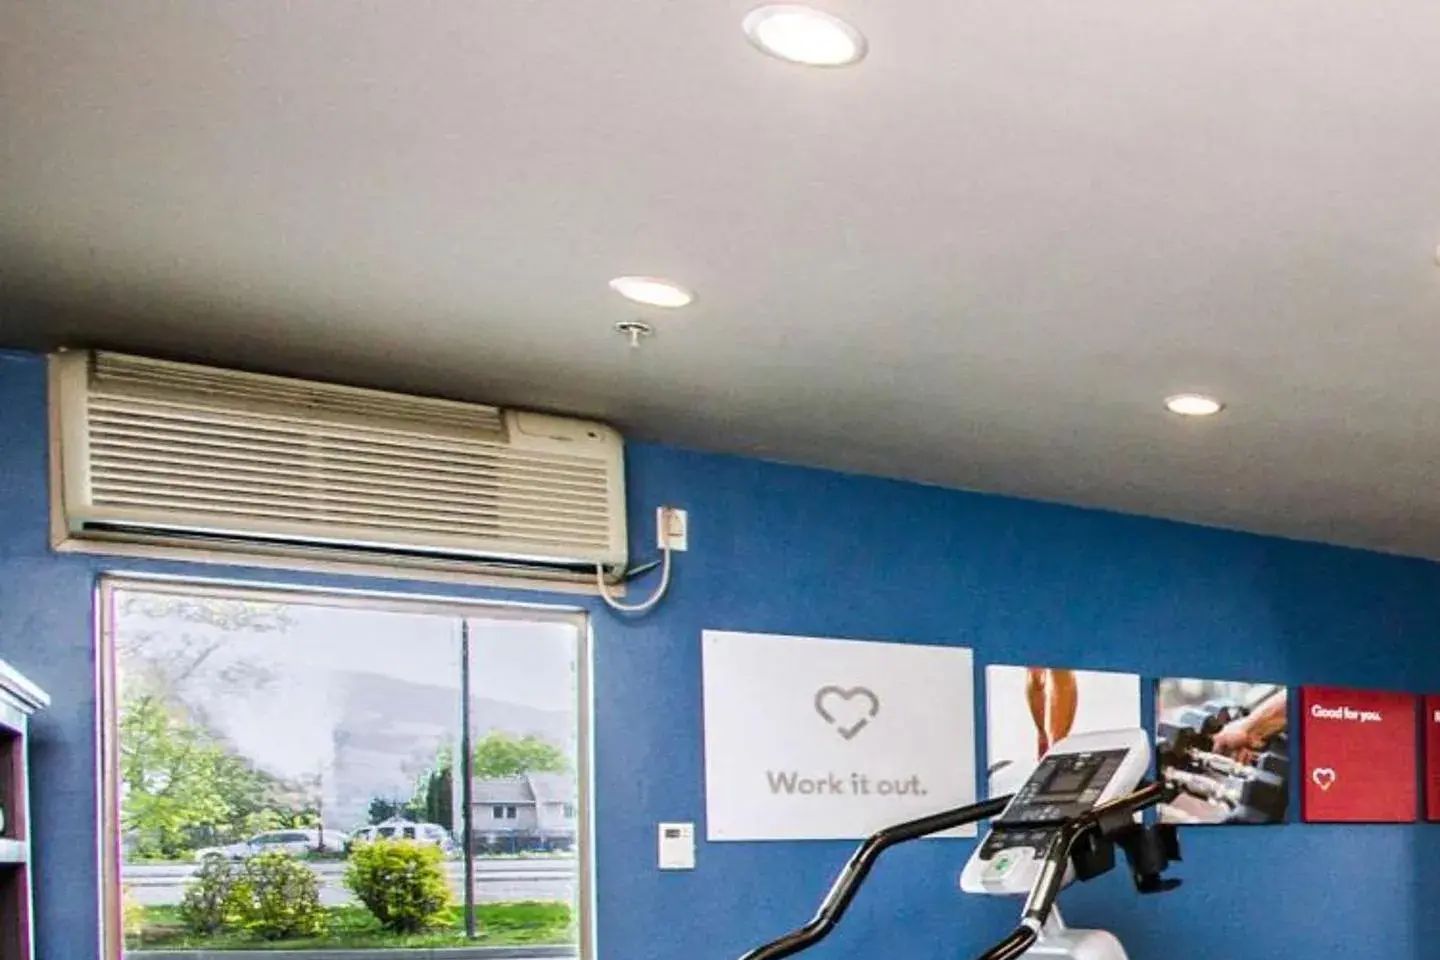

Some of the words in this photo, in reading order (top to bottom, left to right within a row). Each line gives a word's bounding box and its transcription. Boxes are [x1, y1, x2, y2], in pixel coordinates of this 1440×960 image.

[1311, 704, 1342, 719] Good
[1344, 706, 1359, 720] for
[1360, 711, 1383, 723] you.
[766, 769, 844, 795] Work
[851, 772, 871, 796] it
[876, 774, 929, 796] out.
